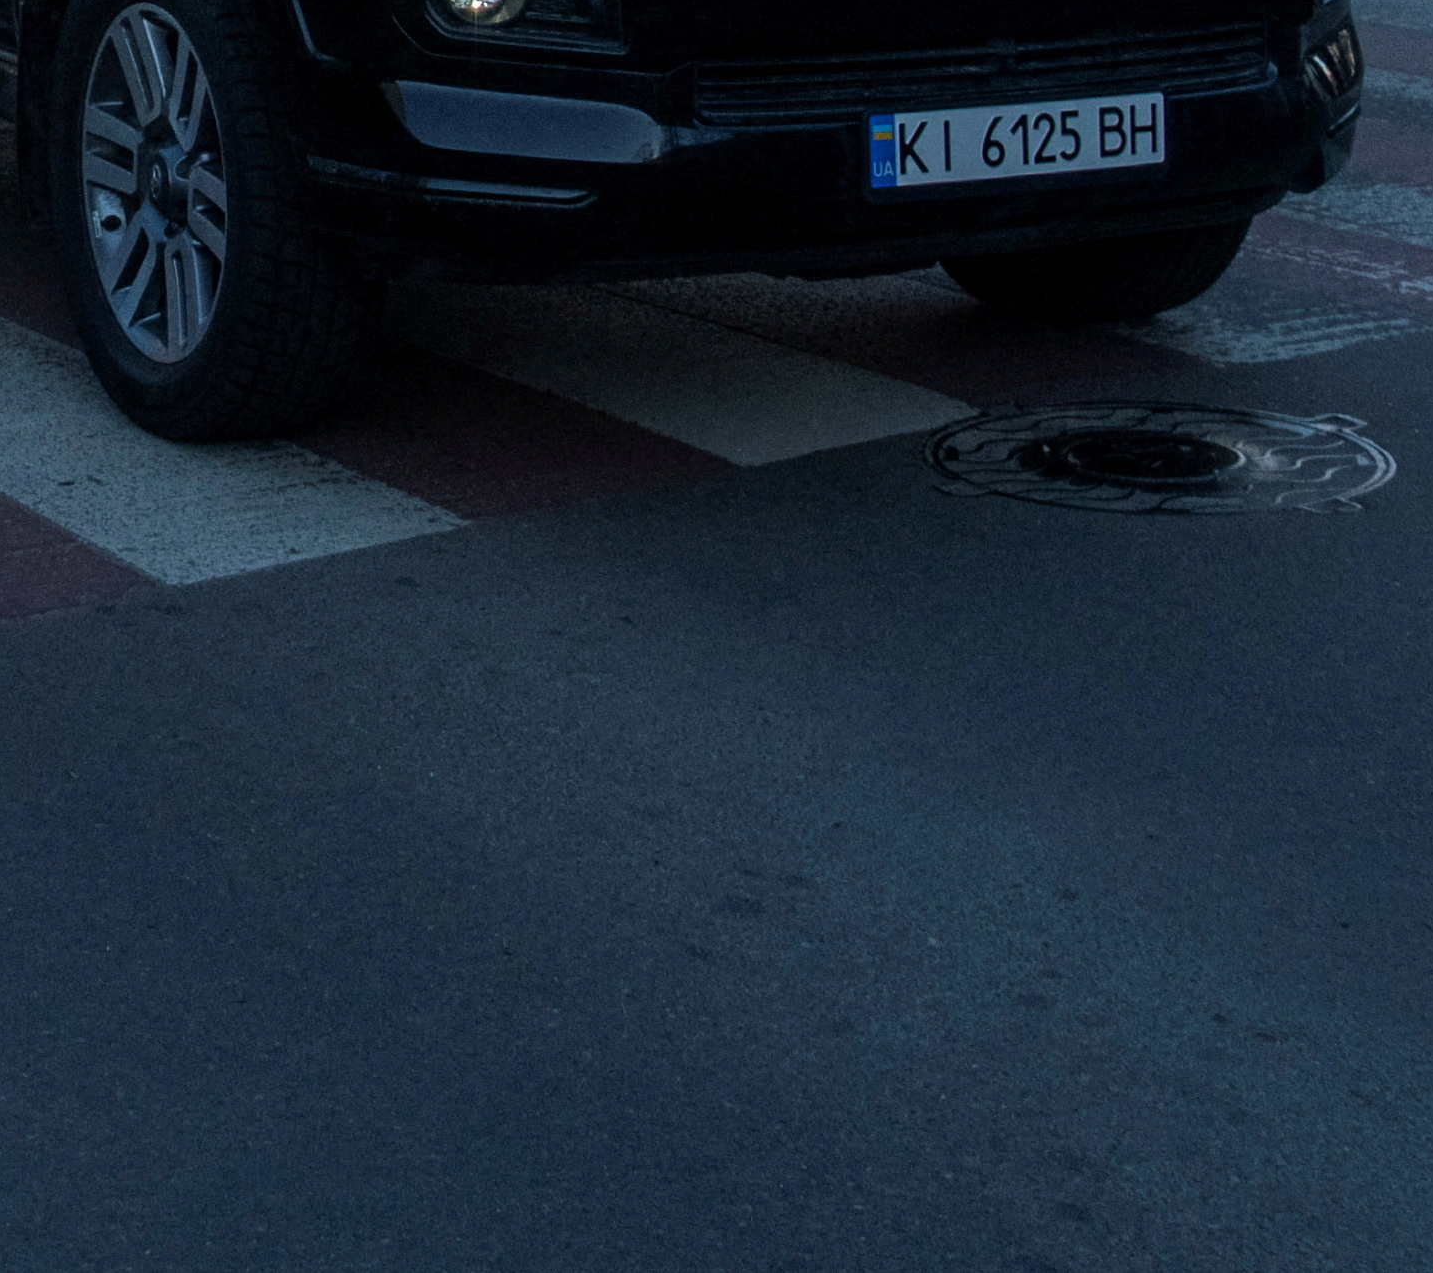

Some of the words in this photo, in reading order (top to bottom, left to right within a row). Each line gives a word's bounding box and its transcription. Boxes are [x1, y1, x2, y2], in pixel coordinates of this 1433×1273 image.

[981, 109, 1082, 168] 6125
[1098, 102, 1158, 159] BH
[872, 161, 895, 178] UA
